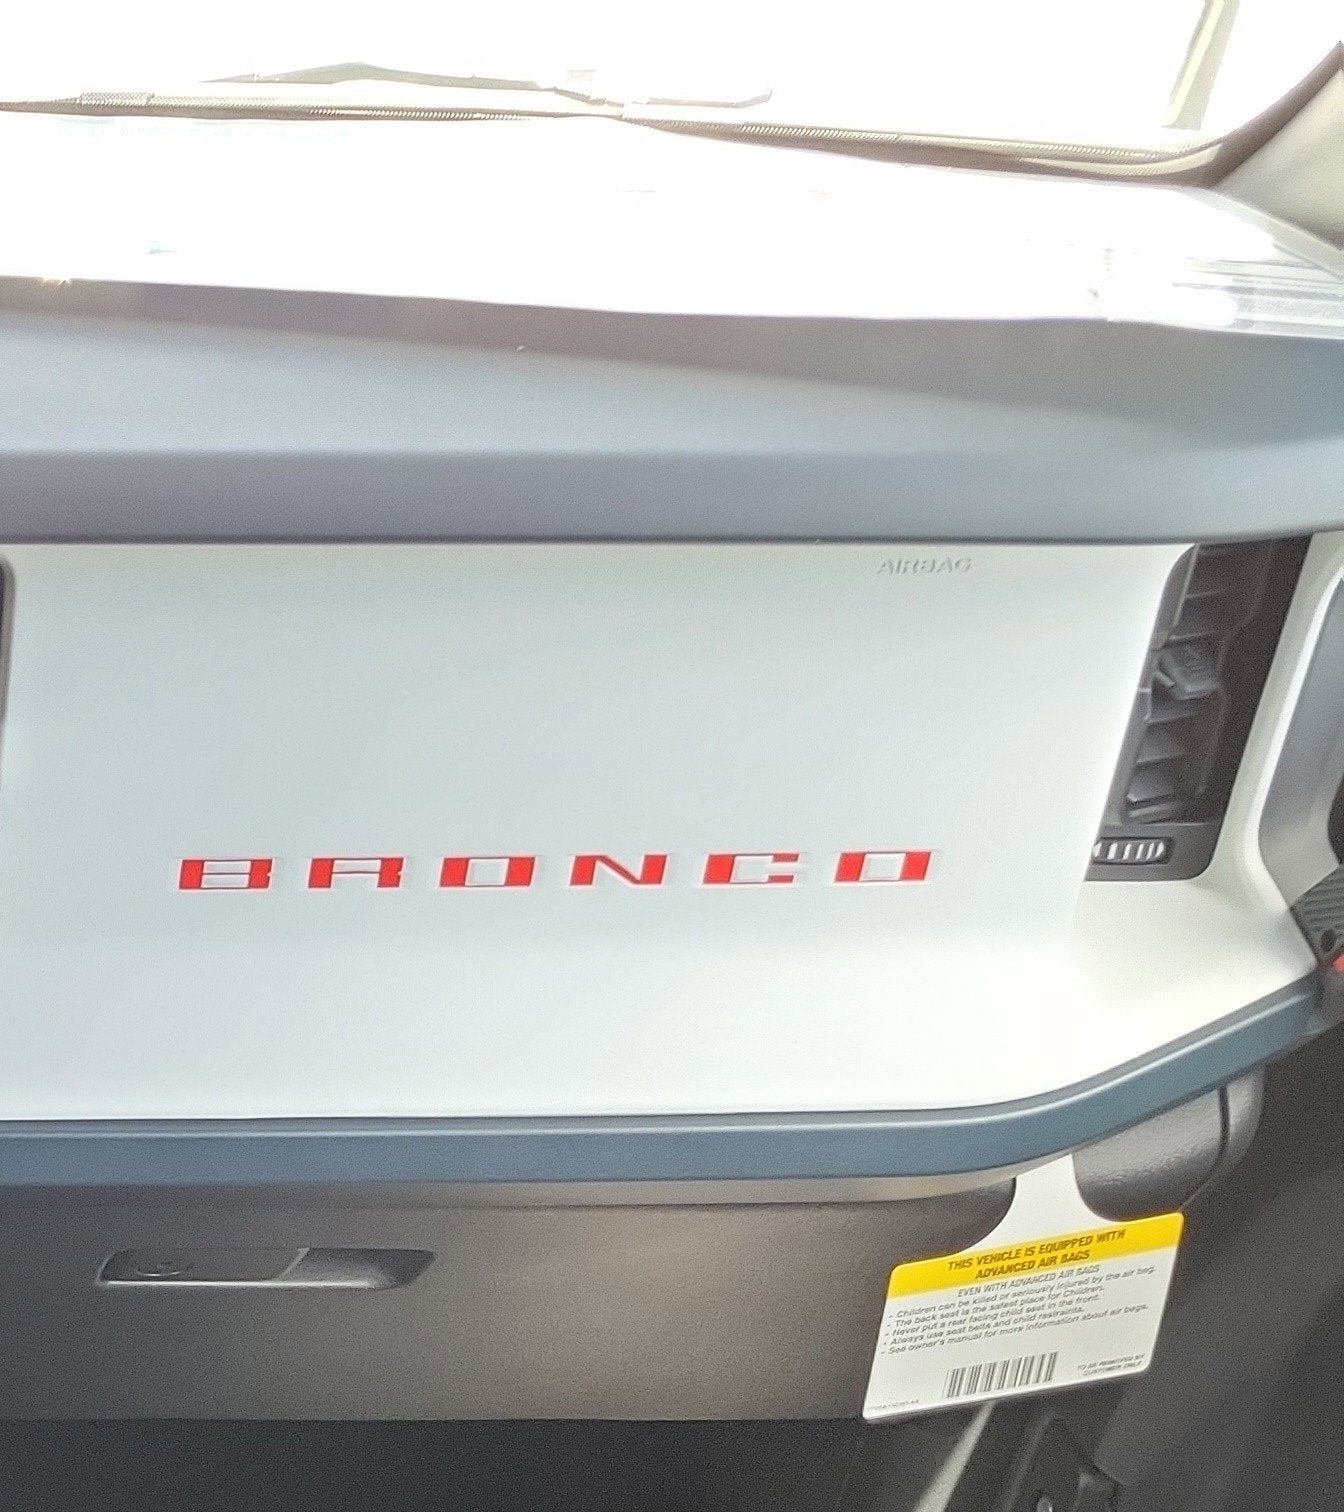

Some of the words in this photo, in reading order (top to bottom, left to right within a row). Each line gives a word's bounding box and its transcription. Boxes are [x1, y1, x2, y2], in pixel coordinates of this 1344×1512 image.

[876, 556, 973, 576] AIRBAG
[177, 851, 933, 890] BRONCO
[948, 1257, 972, 1271] THIS
[975, 1248, 1021, 1266] VEHICLE
[1024, 1245, 1036, 1257] IS
[1037, 1235, 1093, 1254] EQUIPPED
[1095, 1229, 1125, 1244] WITH
[974, 1259, 1035, 1279] ADVANCED
[1037, 1255, 1058, 1268] AIR
[1060, 1249, 1090, 1264] BAGS
